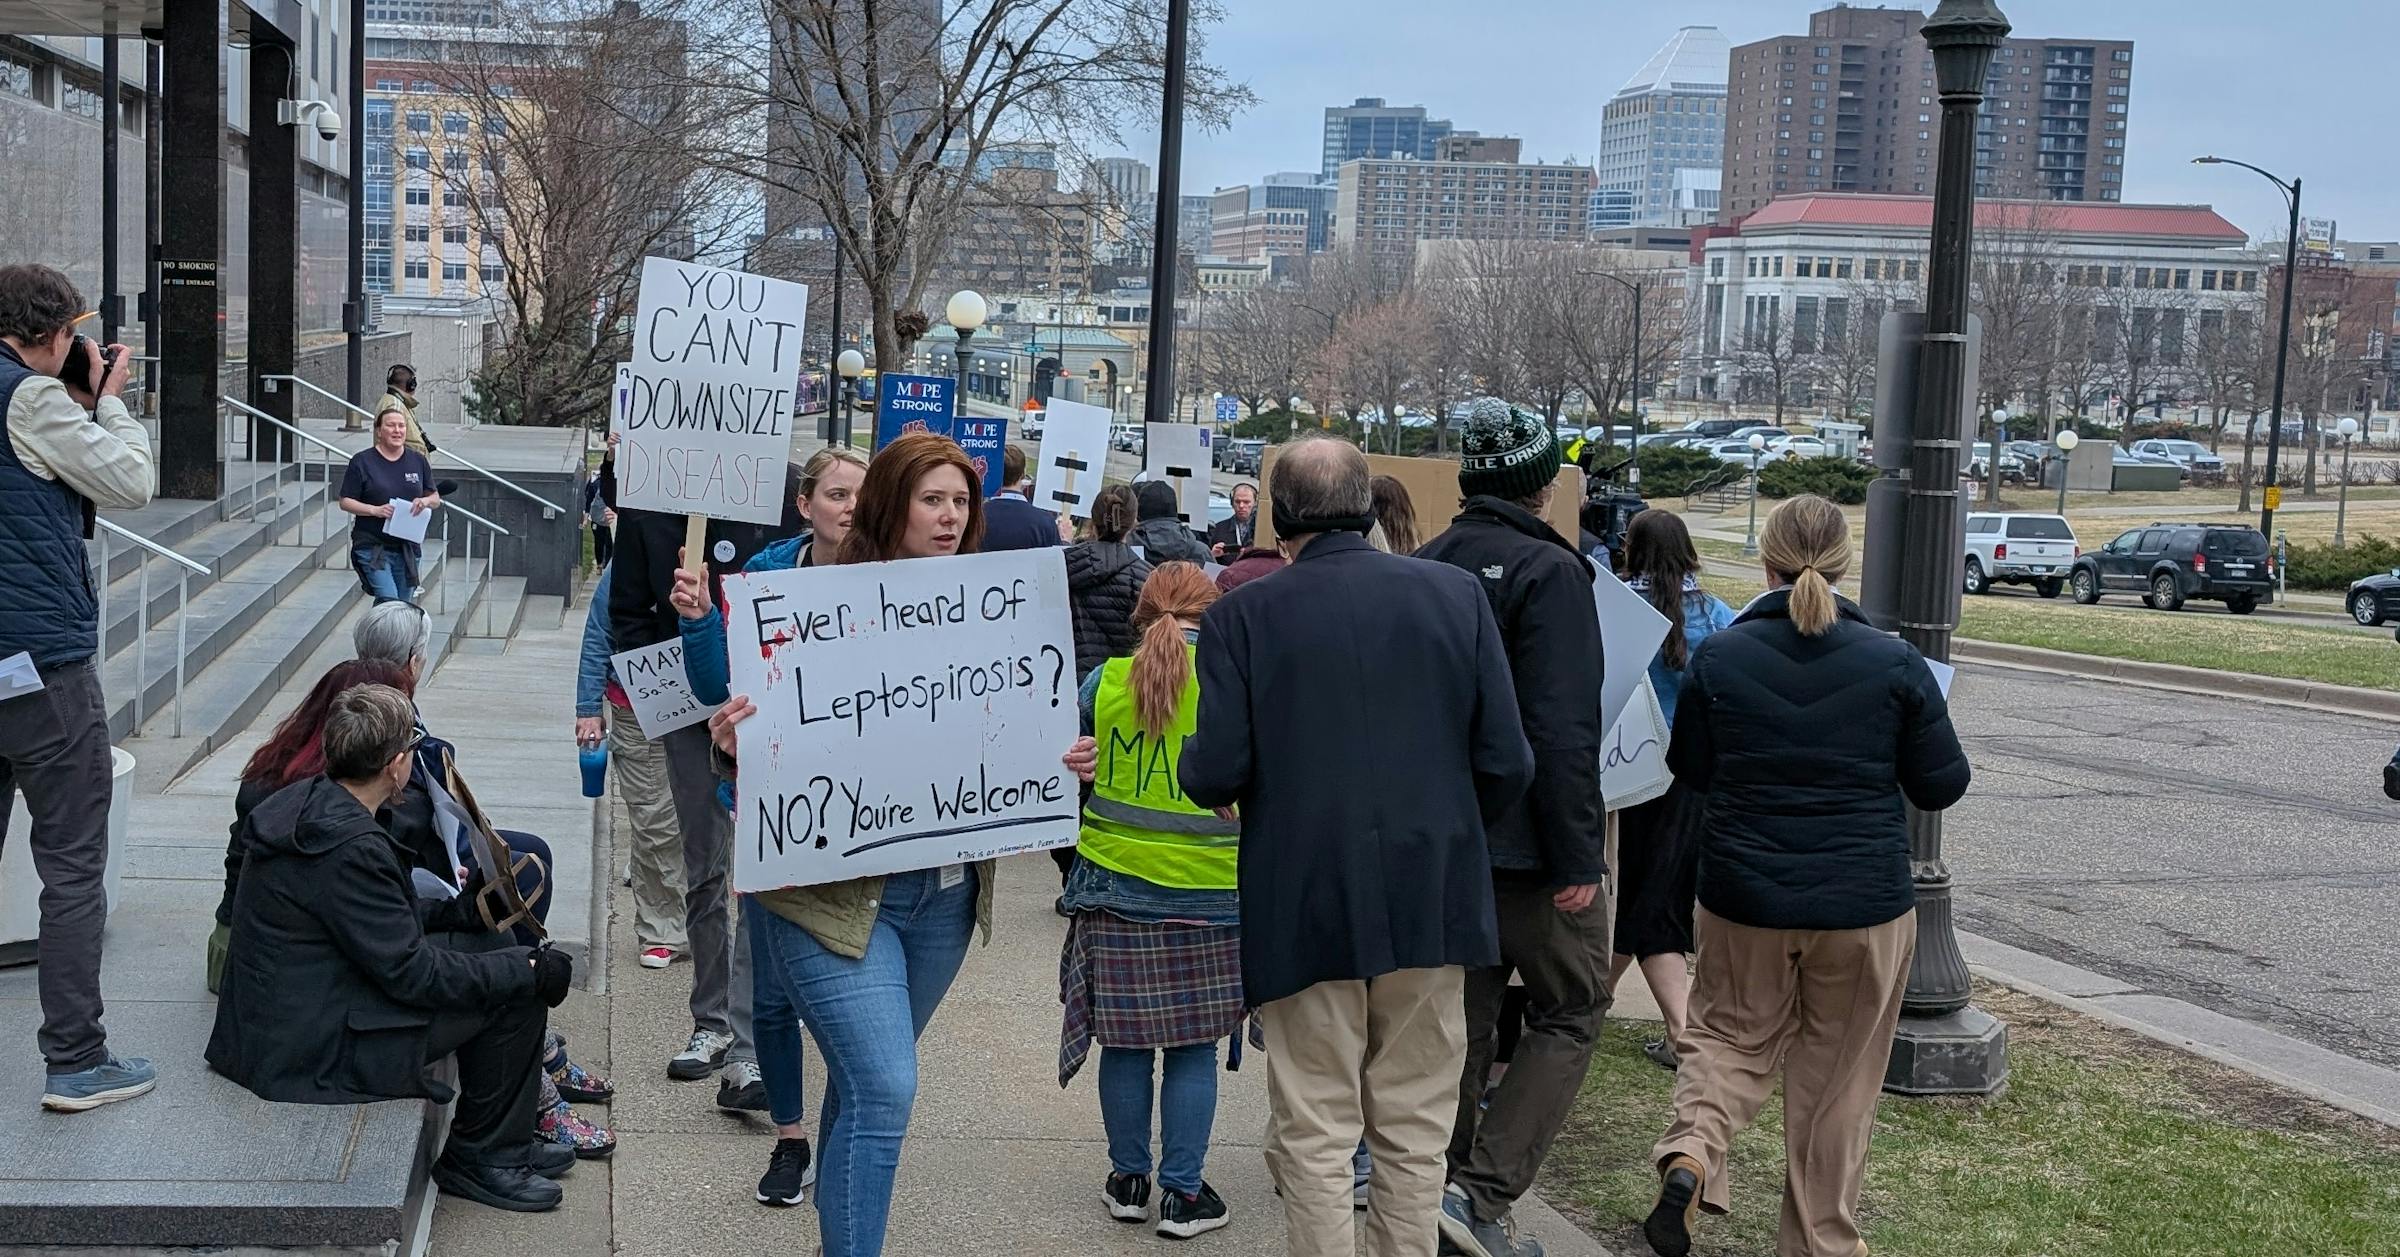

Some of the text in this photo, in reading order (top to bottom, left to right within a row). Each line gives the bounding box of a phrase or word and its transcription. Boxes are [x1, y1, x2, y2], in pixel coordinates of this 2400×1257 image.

[163, 261, 216, 271] NO SMOKING
[677, 267, 765, 314] YOU
[649, 306, 797, 374] CAN'T
[628, 374, 790, 437] DOWNSIZE
[892, 398, 943, 413] STRONG
[624, 440, 775, 508] DISEASE
[960, 438, 998, 449] STRONG
[752, 594, 851, 646] Ever
[879, 583, 966, 632] heard
[656, 700, 698, 722] Good
[795, 644, 1065, 738] Leptospirosis?
[1108, 726, 1187, 802] MA
[758, 775, 834, 862] NO?
[931, 762, 1065, 821] Welcome
